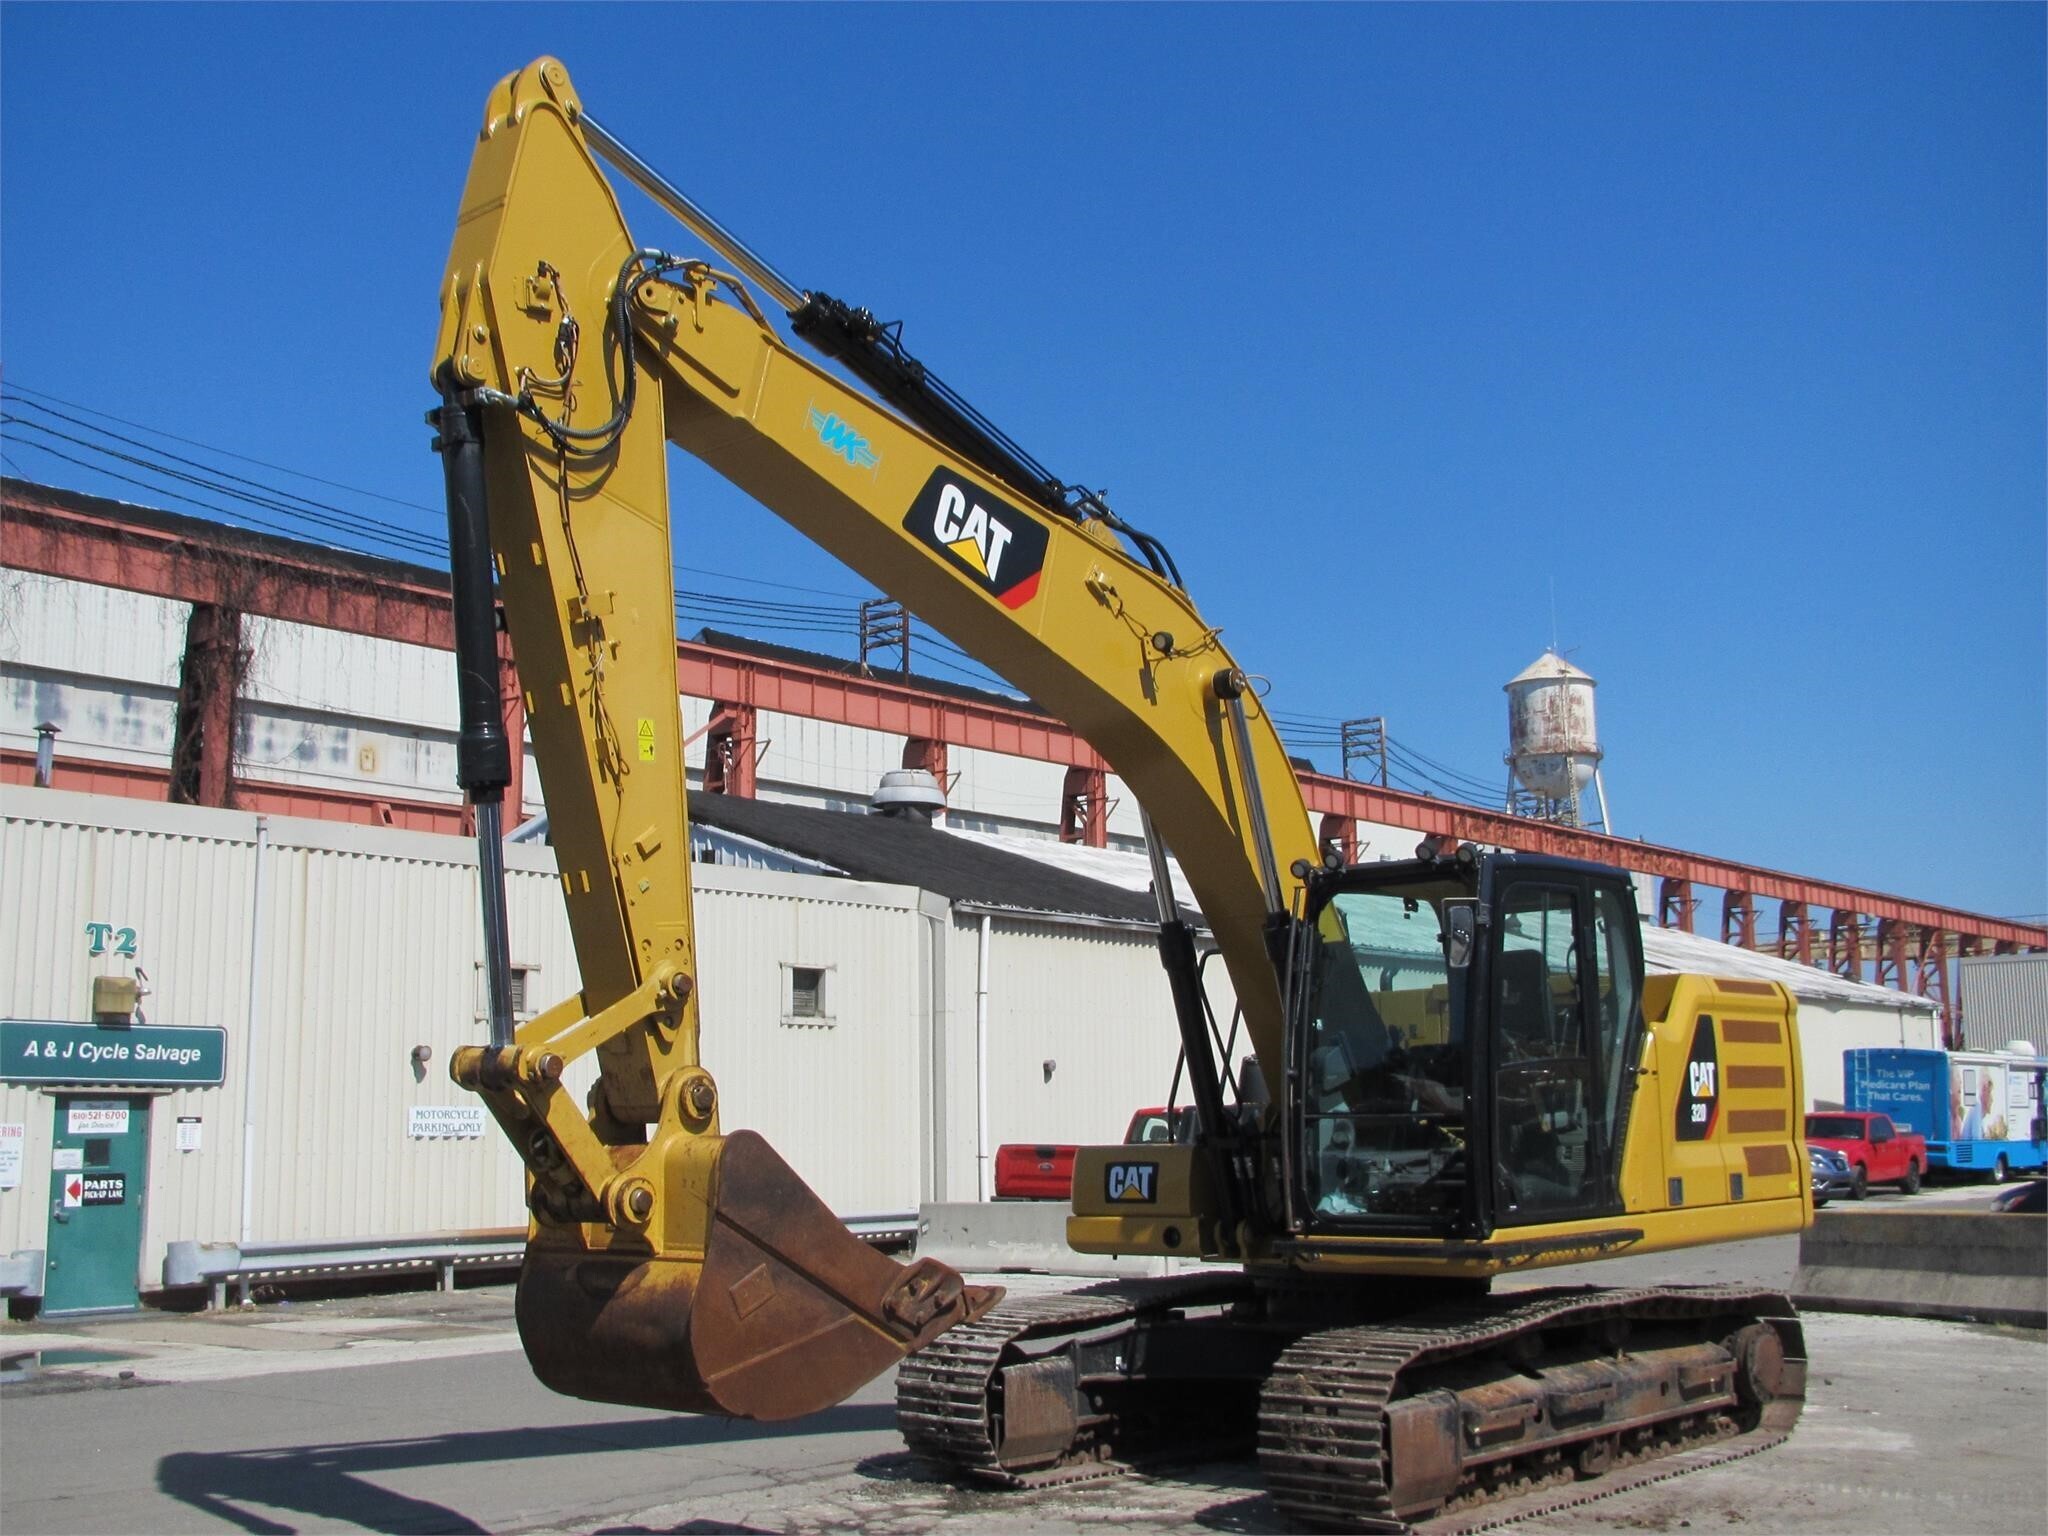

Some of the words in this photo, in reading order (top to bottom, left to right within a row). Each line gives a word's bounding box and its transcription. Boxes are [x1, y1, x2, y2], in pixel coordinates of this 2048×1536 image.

[933, 483, 1013, 583] CAT
[24, 1040, 39, 1057] A
[44, 1040, 58, 1058] &
[62, 1041, 75, 1059] J
[78, 1041, 130, 1063] Cycle
[134, 1043, 202, 1065] Salvage
[1689, 1061, 1716, 1097] CAT
[1876, 1068, 1896, 1079] The
[1860, 1080, 1906, 1090] Medicare
[1908, 1080, 1931, 1090] Plan
[1867, 1090, 1891, 1101] That
[415, 1109, 480, 1120] MOTORCYCLE
[1691, 1103, 1707, 1122] 320
[412, 1122, 456, 1134] PARKING
[459, 1122, 483, 1133] ONLY
[84, 1179, 124, 1190] PARTS
[1109, 1165, 1153, 1200] CAT
